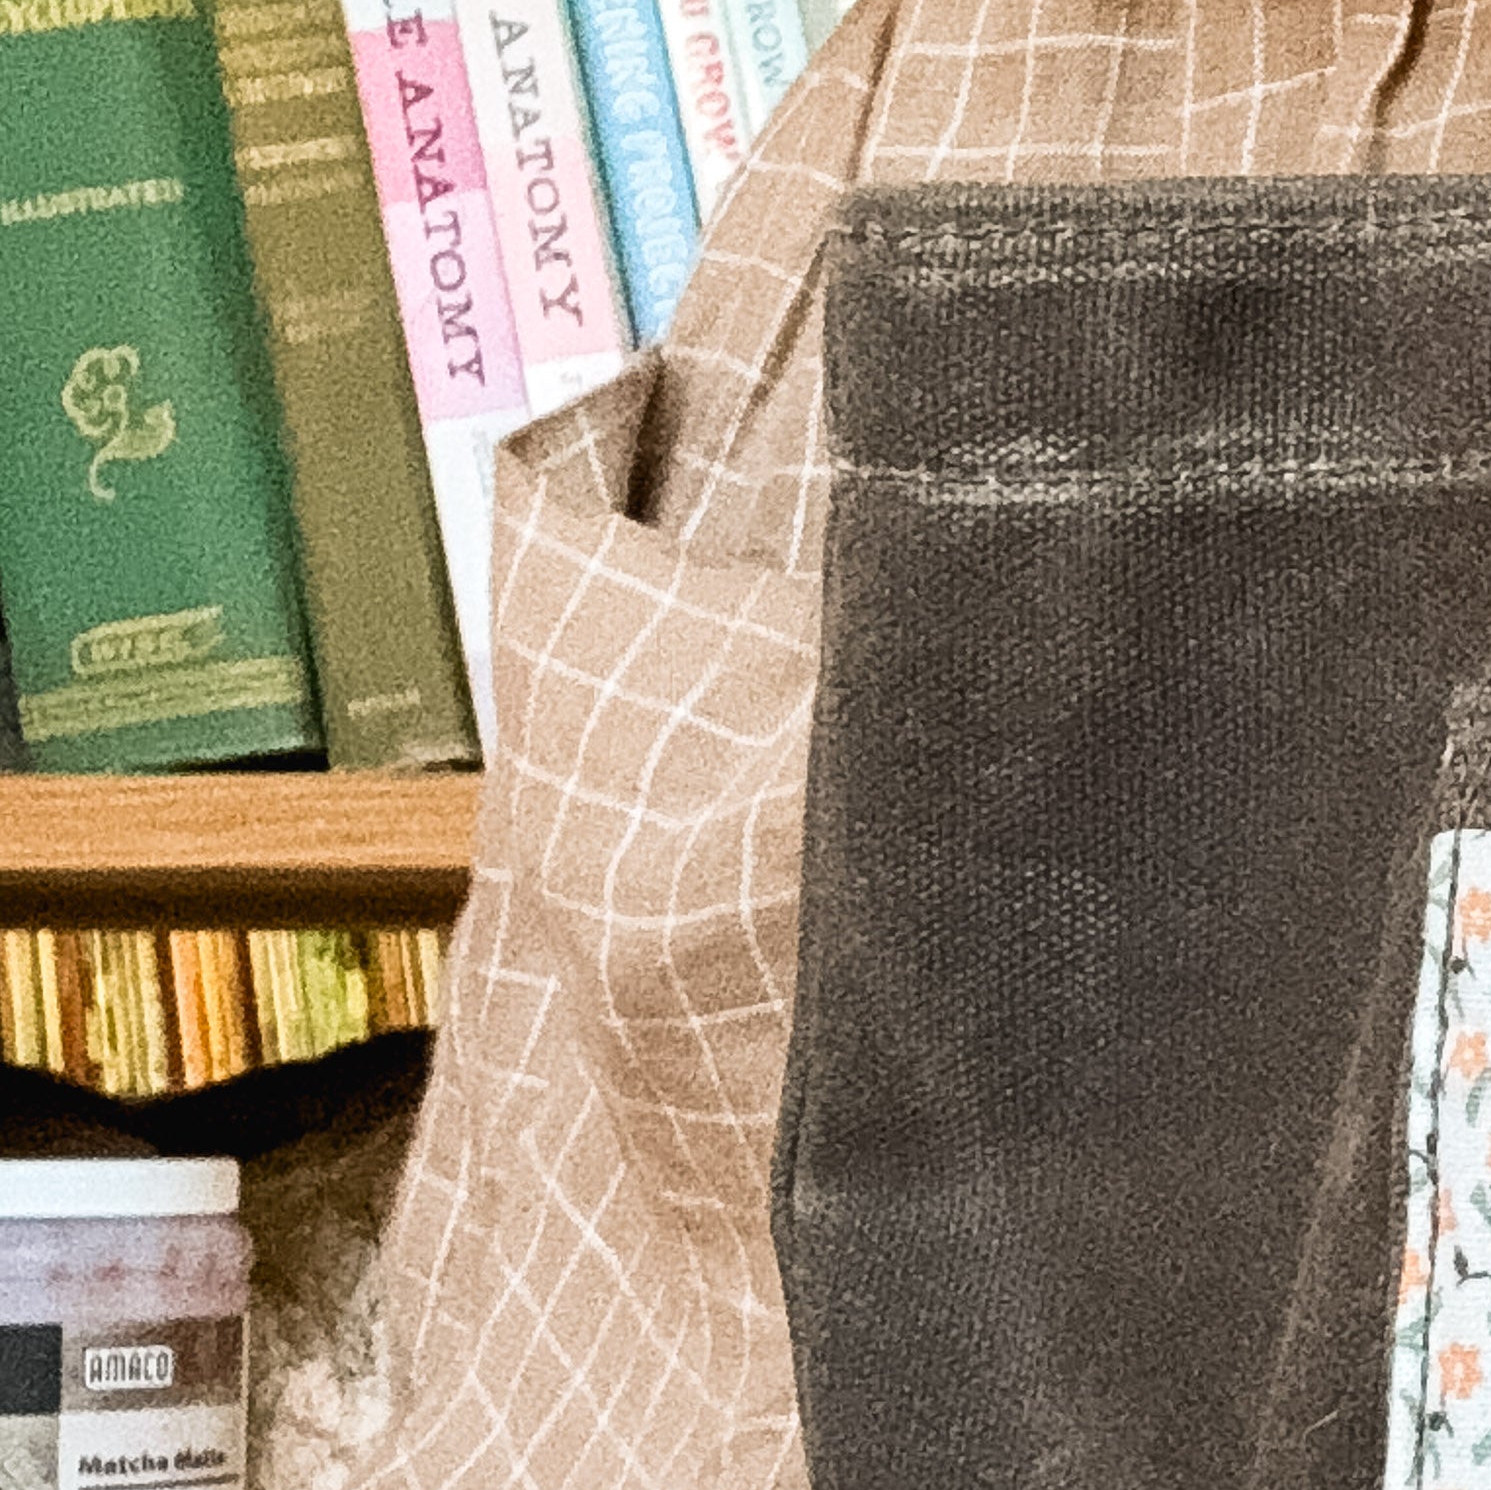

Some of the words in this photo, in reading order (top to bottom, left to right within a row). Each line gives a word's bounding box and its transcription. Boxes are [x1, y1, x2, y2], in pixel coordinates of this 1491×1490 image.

[396, 70, 486, 388] ANATOMY
[489, 10, 584, 328] ANATOMY
[90, 1350, 170, 1384] AMACO
[78, 1452, 169, 1476] Matcha
